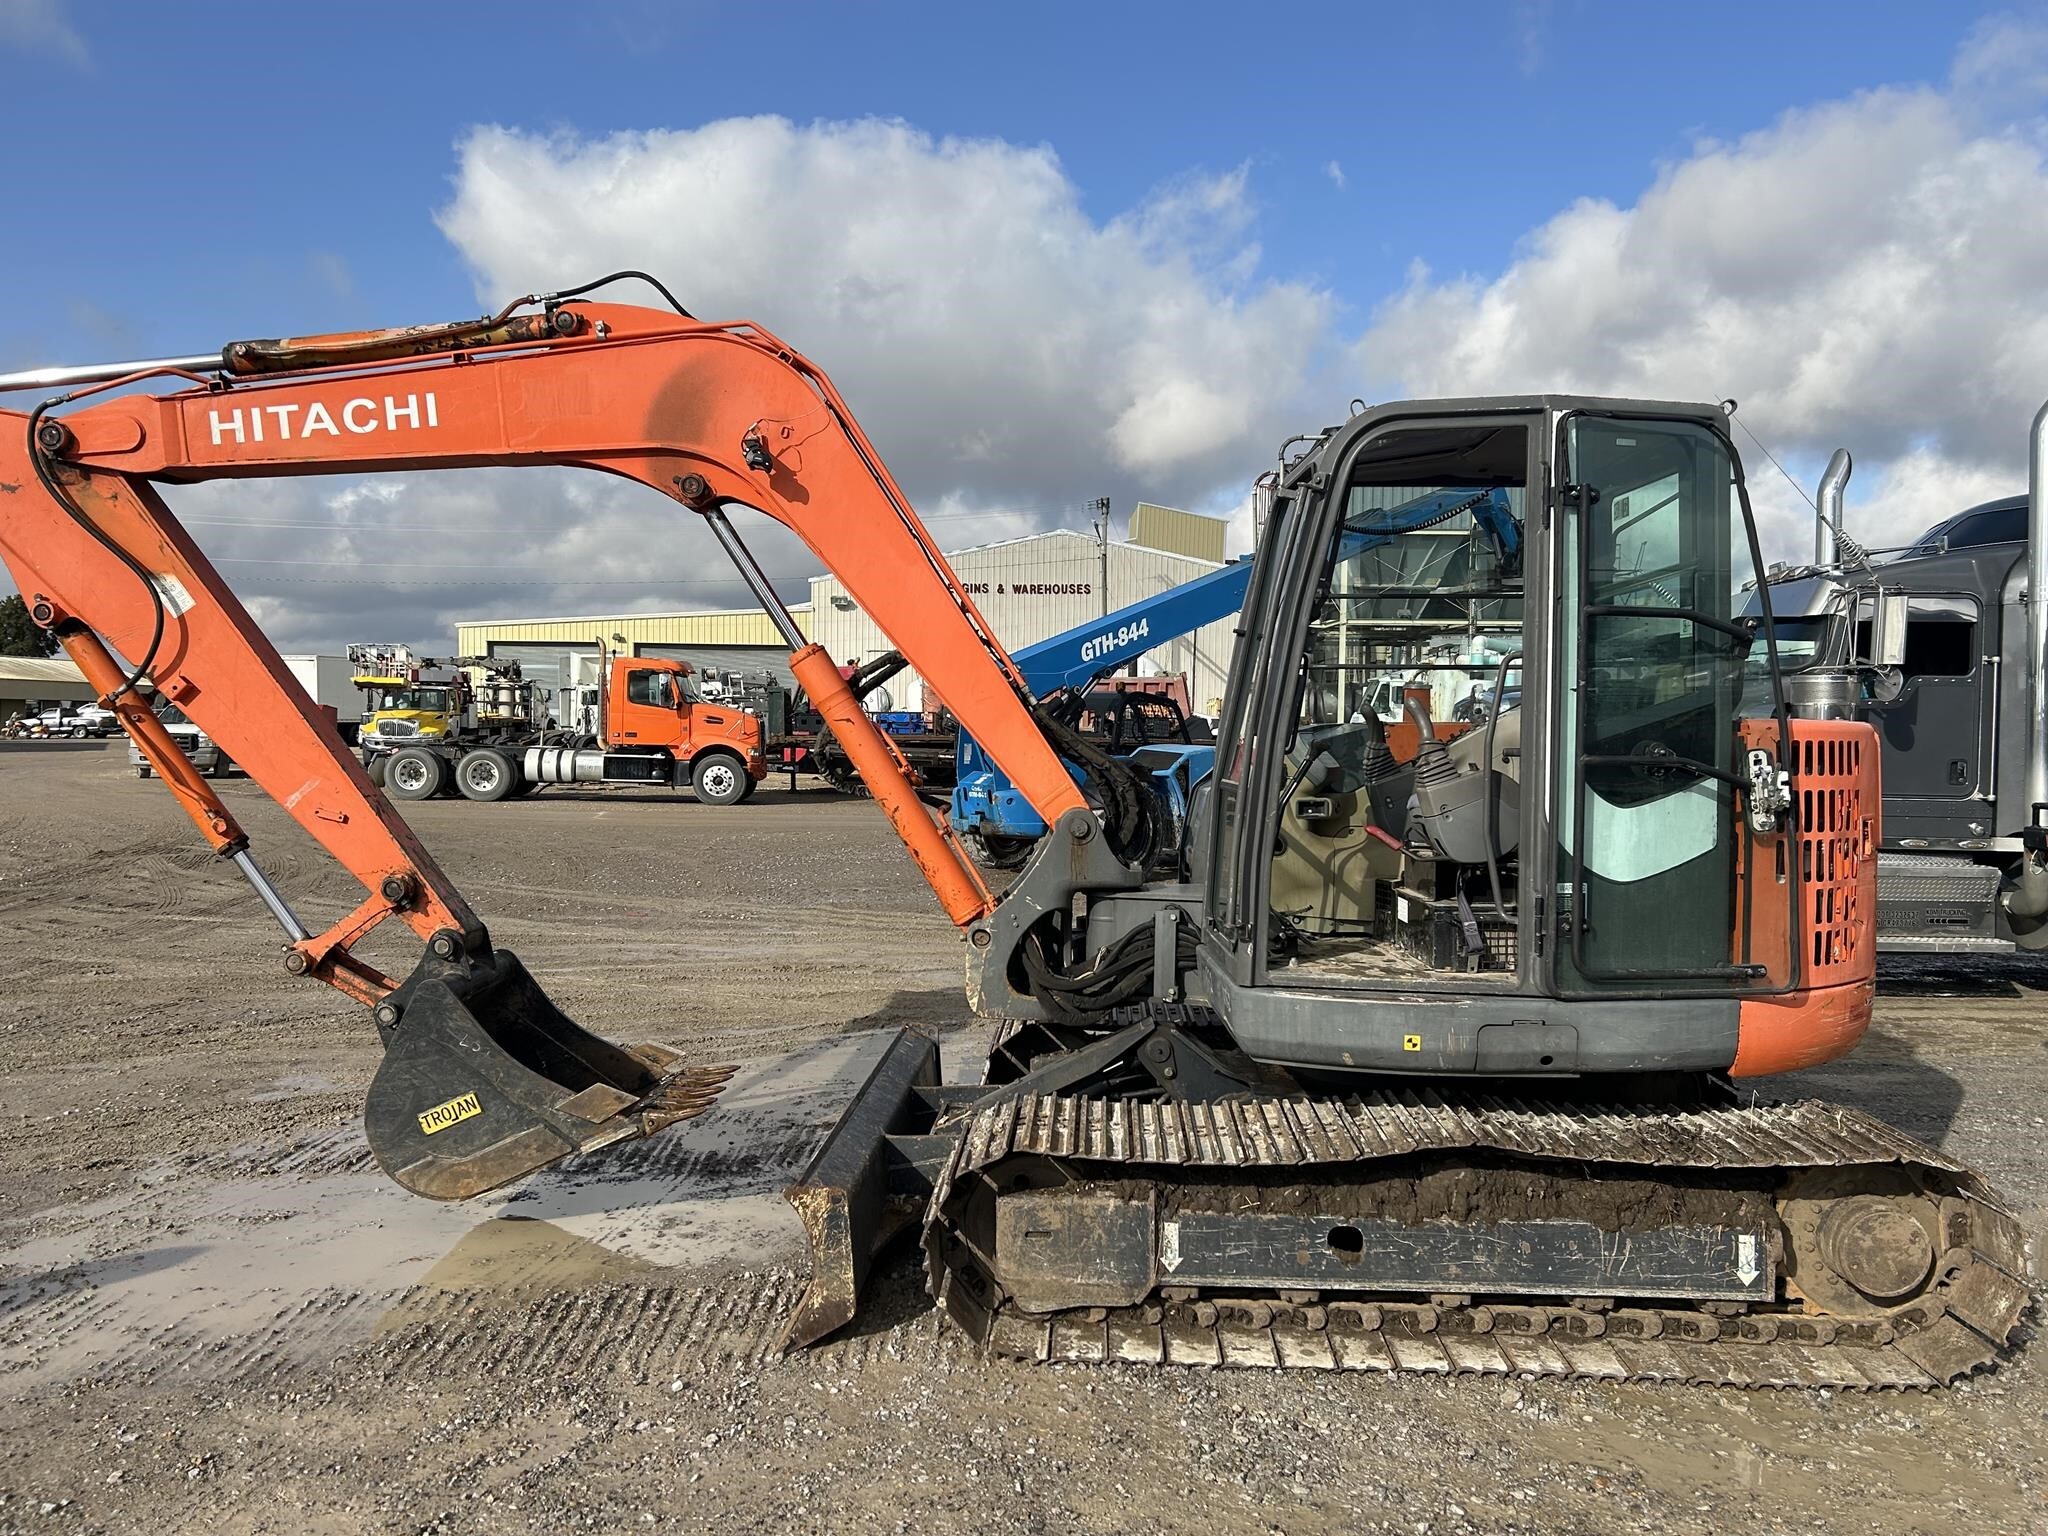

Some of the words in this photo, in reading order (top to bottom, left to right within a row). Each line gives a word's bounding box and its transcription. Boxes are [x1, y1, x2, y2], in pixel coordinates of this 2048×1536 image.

[208, 392, 438, 445] HITACHI
[962, 583, 989, 594] GINS
[997, 583, 1005, 594] &
[1012, 583, 1091, 595] WAREHOUSES
[1081, 617, 1149, 662] GTH-844
[421, 1096, 478, 1129] TROJAN
